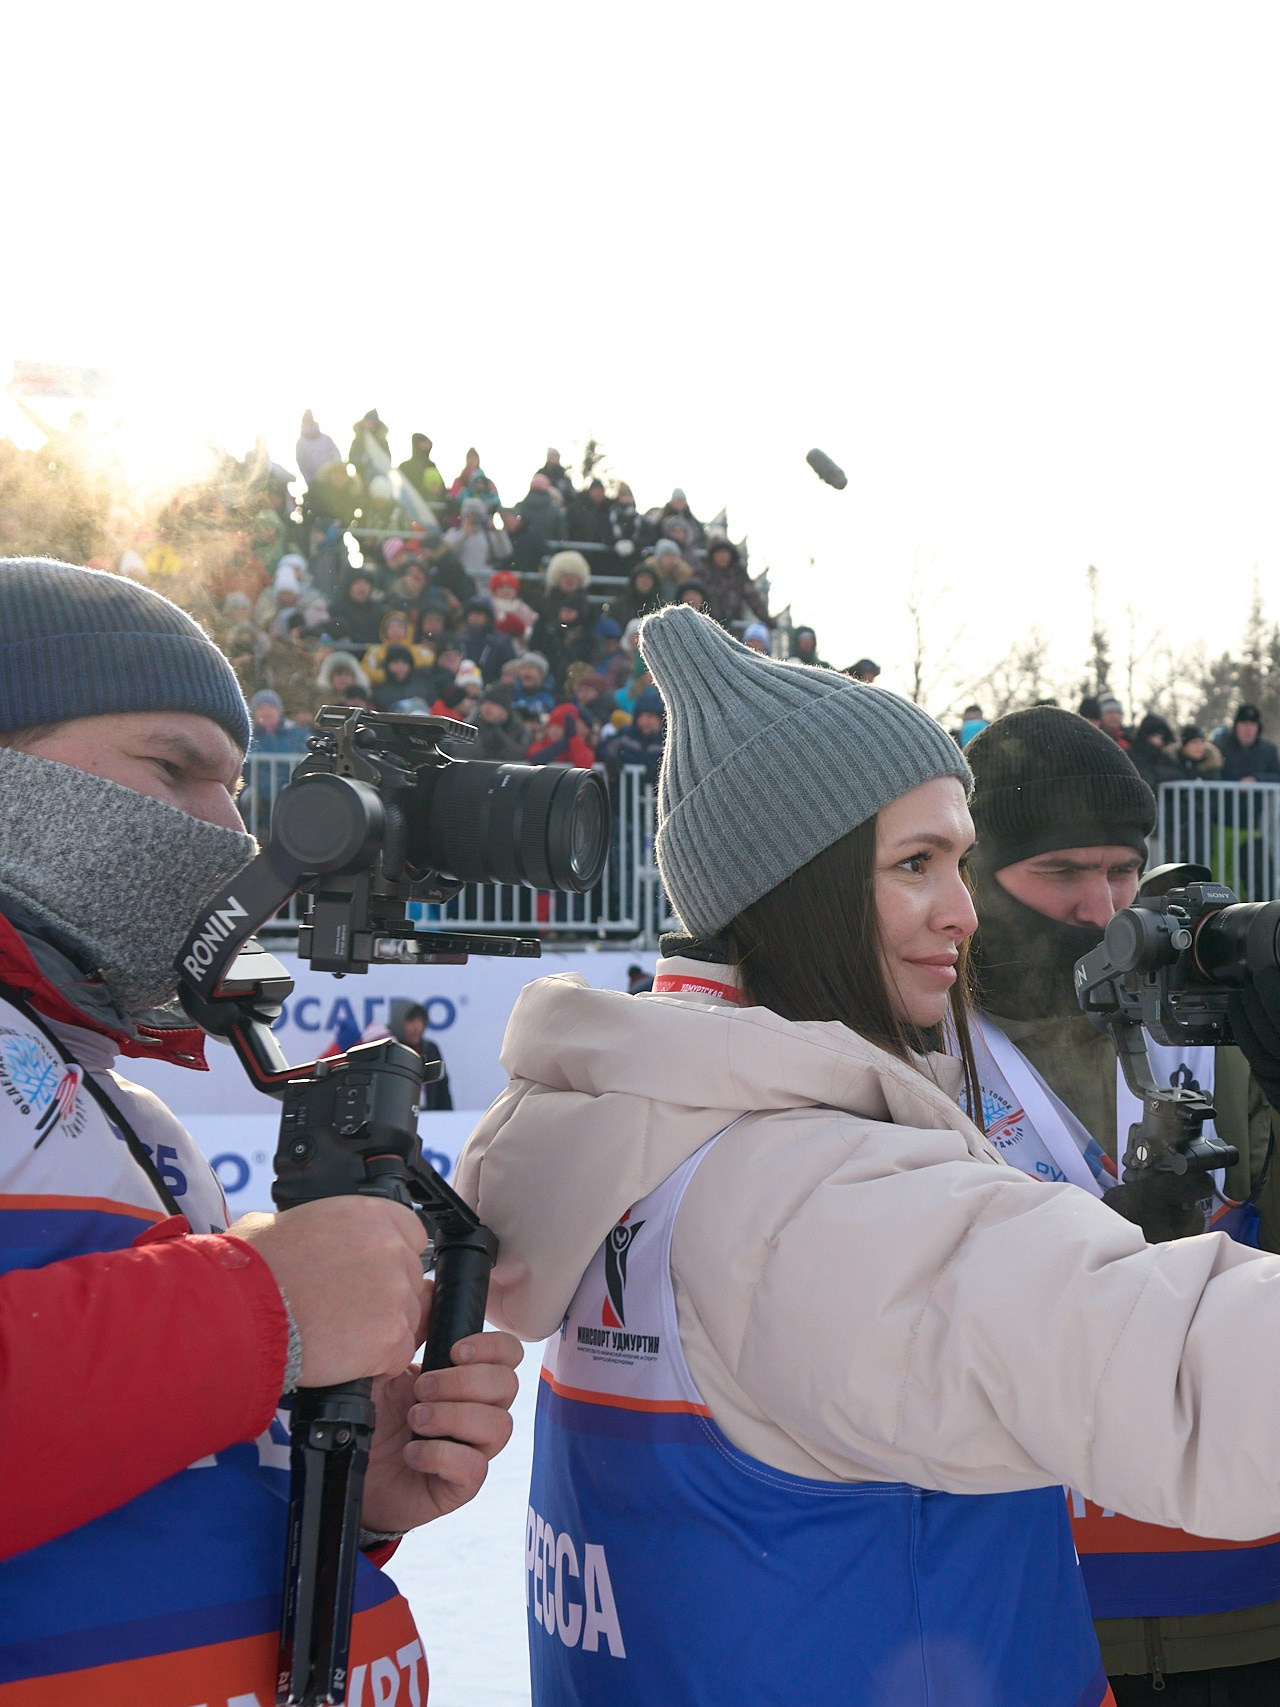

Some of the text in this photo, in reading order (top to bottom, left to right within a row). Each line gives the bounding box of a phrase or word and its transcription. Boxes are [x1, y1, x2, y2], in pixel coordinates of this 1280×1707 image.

[183, 895, 250, 982] RONIN
[988, 1089, 1013, 1110] ГОНОК
[577, 1326, 610, 1348] МИНСПОРТ
[612, 1332, 660, 1354] УДМУРТИИ
